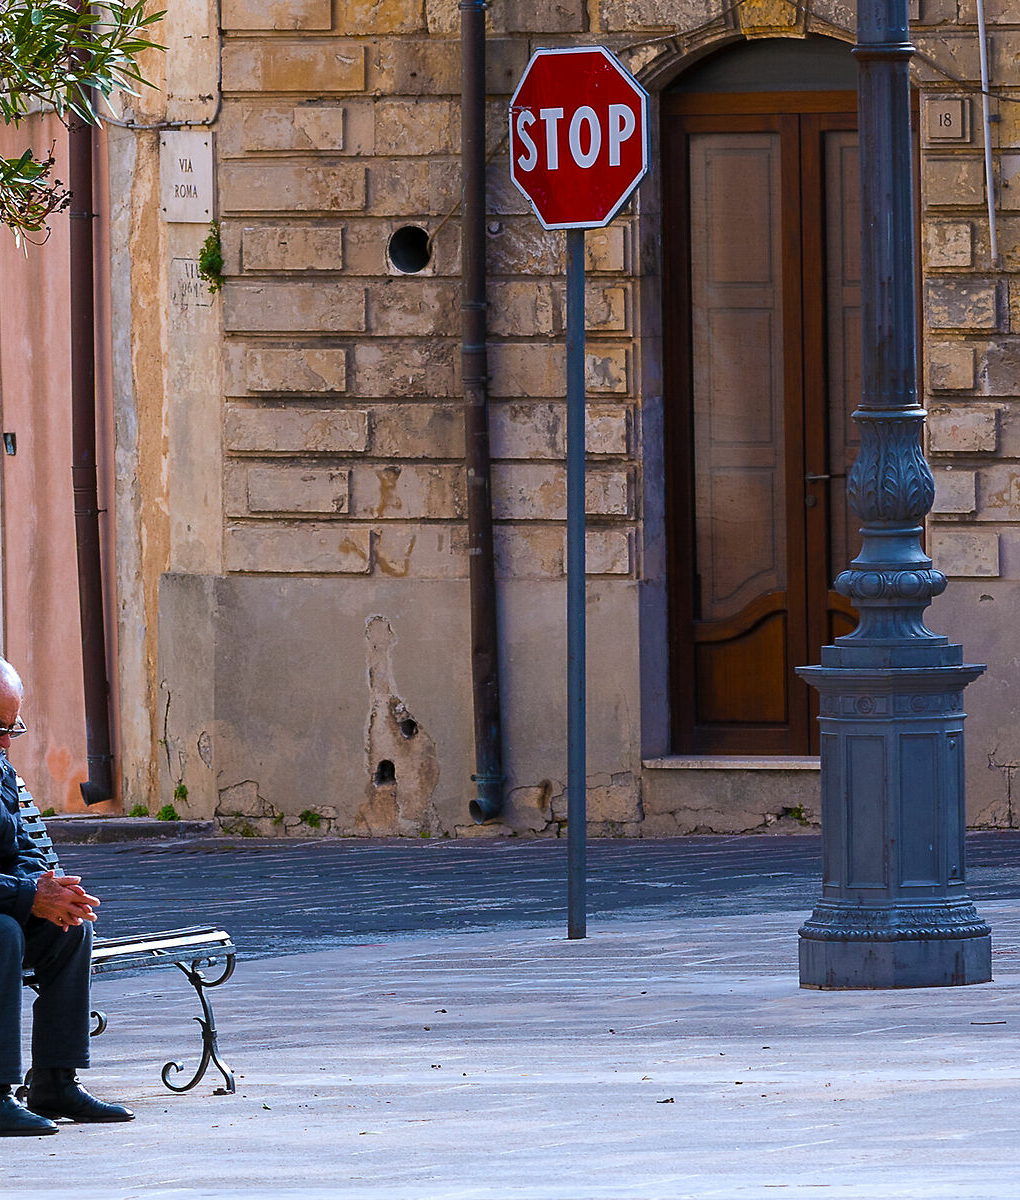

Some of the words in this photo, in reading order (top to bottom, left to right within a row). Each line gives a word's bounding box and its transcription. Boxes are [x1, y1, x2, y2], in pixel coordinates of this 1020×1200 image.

[939, 112, 952, 127] 18
[517, 103, 636, 172] STOP
[178, 158, 193, 173] VIA
[174, 184, 198, 198] ROMA
